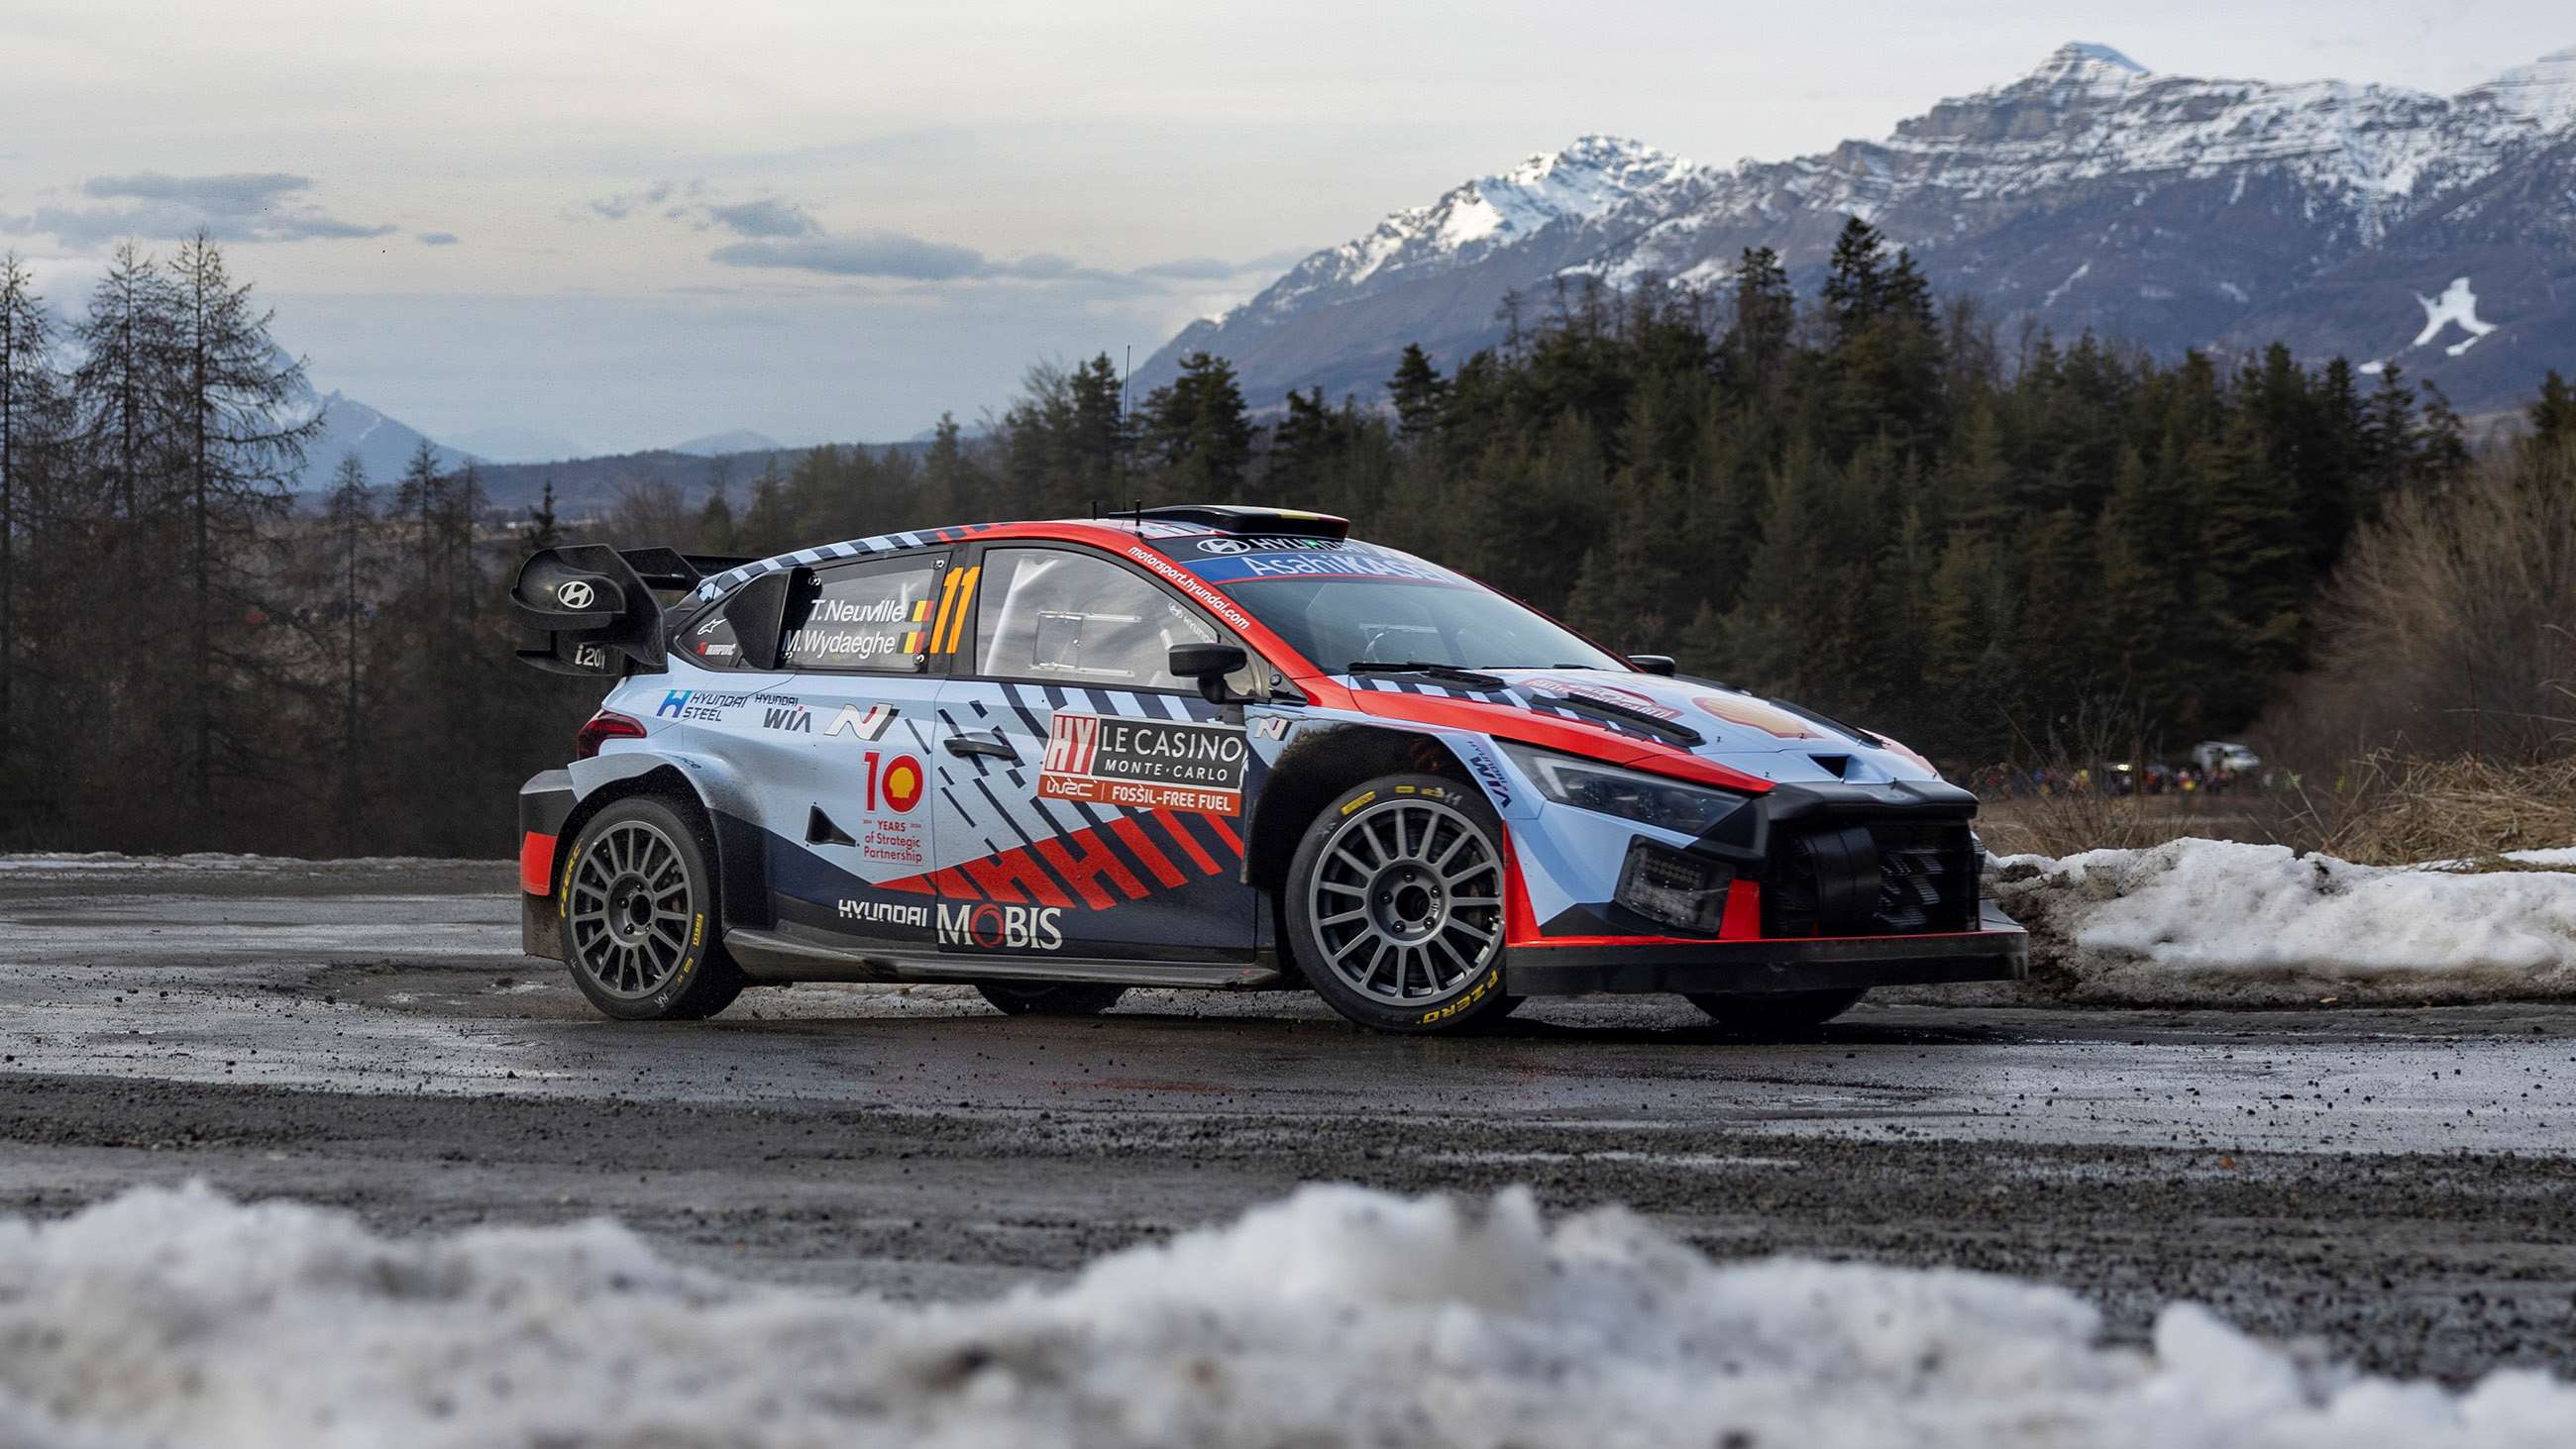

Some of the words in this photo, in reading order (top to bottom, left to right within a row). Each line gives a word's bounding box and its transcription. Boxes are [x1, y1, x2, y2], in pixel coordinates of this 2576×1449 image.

[1127, 546, 1250, 630] motorsport.hyundai.com
[810, 599, 906, 622] T.Neuville
[929, 567, 981, 655] 11
[782, 629, 896, 660] M.Wydaeghe
[690, 692, 748, 708] HYUNDAI
[754, 693, 799, 706] HYUNDAI
[683, 706, 722, 722] STEEL
[763, 705, 811, 734] WIA
[1102, 726, 1128, 753] LE
[1134, 729, 1242, 763] CASINO
[1112, 785, 1195, 808] FOSSIL-FREE
[1198, 794, 1232, 811] FUEL
[877, 820, 906, 832] YEARS
[865, 831, 875, 843] of
[877, 833, 920, 850] Strategic
[864, 846, 922, 864] Partnership
[838, 899, 927, 927] HYUNDAI
[937, 902, 1063, 950] MOBIS
